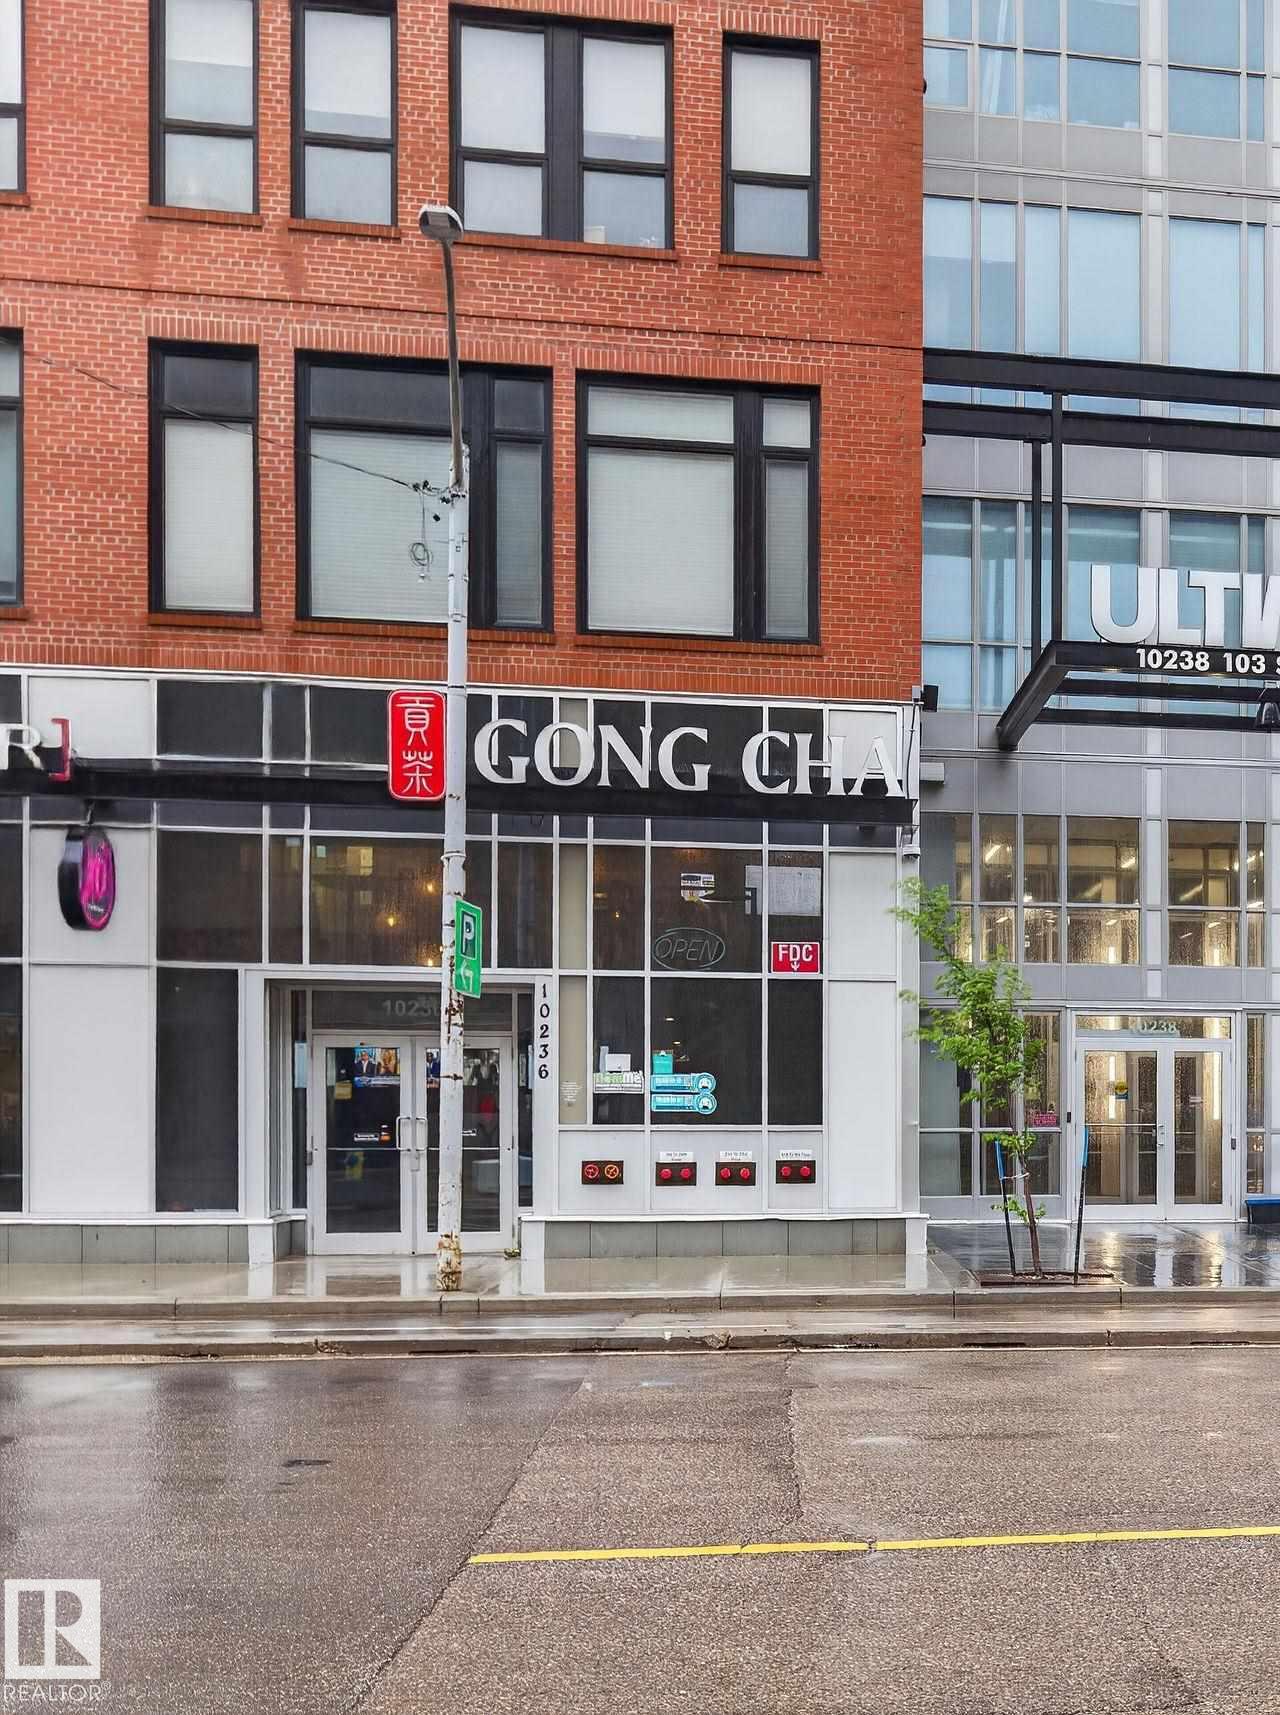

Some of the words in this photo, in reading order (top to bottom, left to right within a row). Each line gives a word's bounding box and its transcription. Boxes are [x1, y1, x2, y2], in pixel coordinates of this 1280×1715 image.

[1135, 647, 1211, 673] 10238
[1222, 651, 1267, 675] 103
[473, 717, 713, 793] GONG
[740, 730, 906, 798] CHA
[462, 914, 475, 954] P
[654, 936, 722, 962] OPEN
[777, 943, 814, 963] FDC
[537, 983, 551, 1080] 10236
